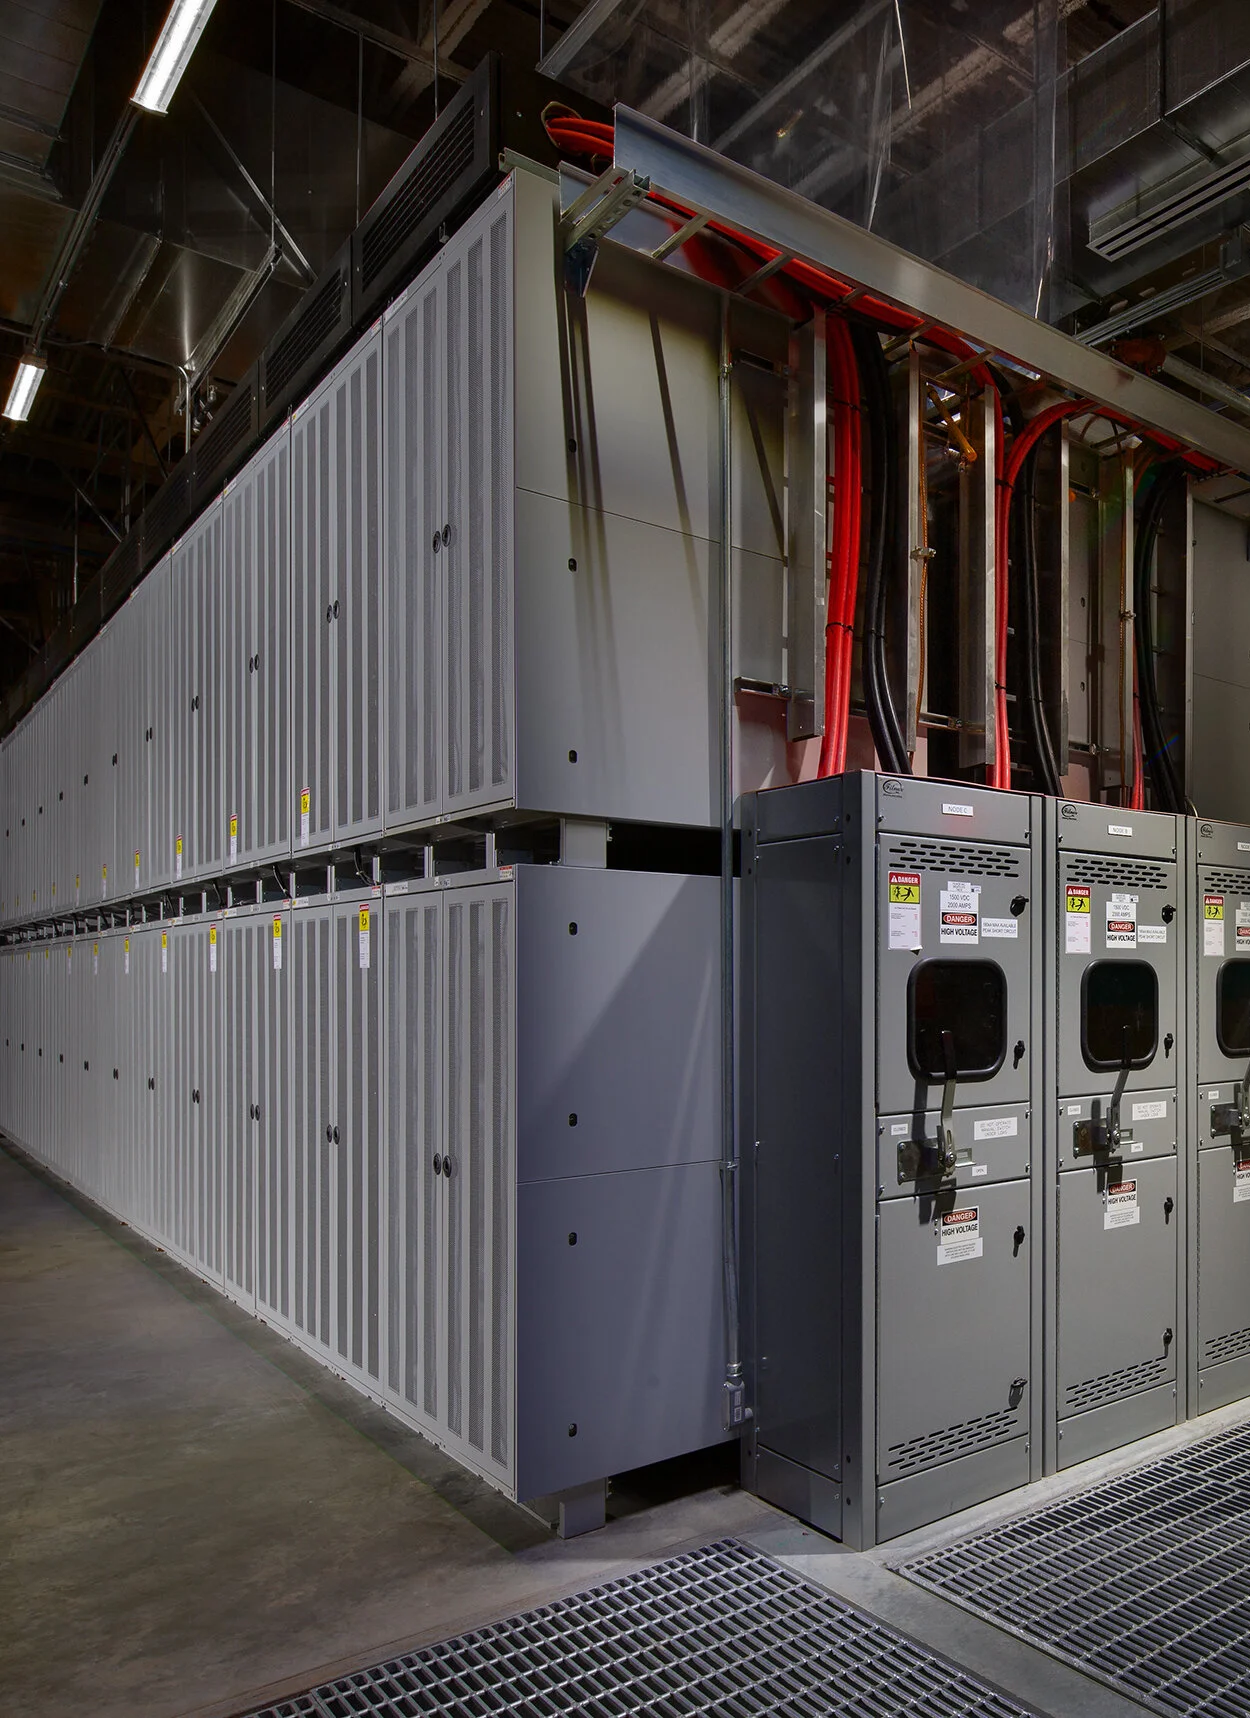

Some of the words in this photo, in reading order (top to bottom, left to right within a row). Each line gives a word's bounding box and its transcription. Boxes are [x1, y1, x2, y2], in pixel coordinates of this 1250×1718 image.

[898, 876, 918, 884] DANGER
[946, 915, 972, 923] DANGER
[941, 928, 954, 936] HIGH
[955, 928, 977, 937] VOLTAGE
[1119, 1194, 1136, 1202] VOLTAGE
[947, 1211, 973, 1222] DANGER
[942, 1228, 954, 1236] HIGH
[956, 1223, 978, 1233] VOLTAGE
